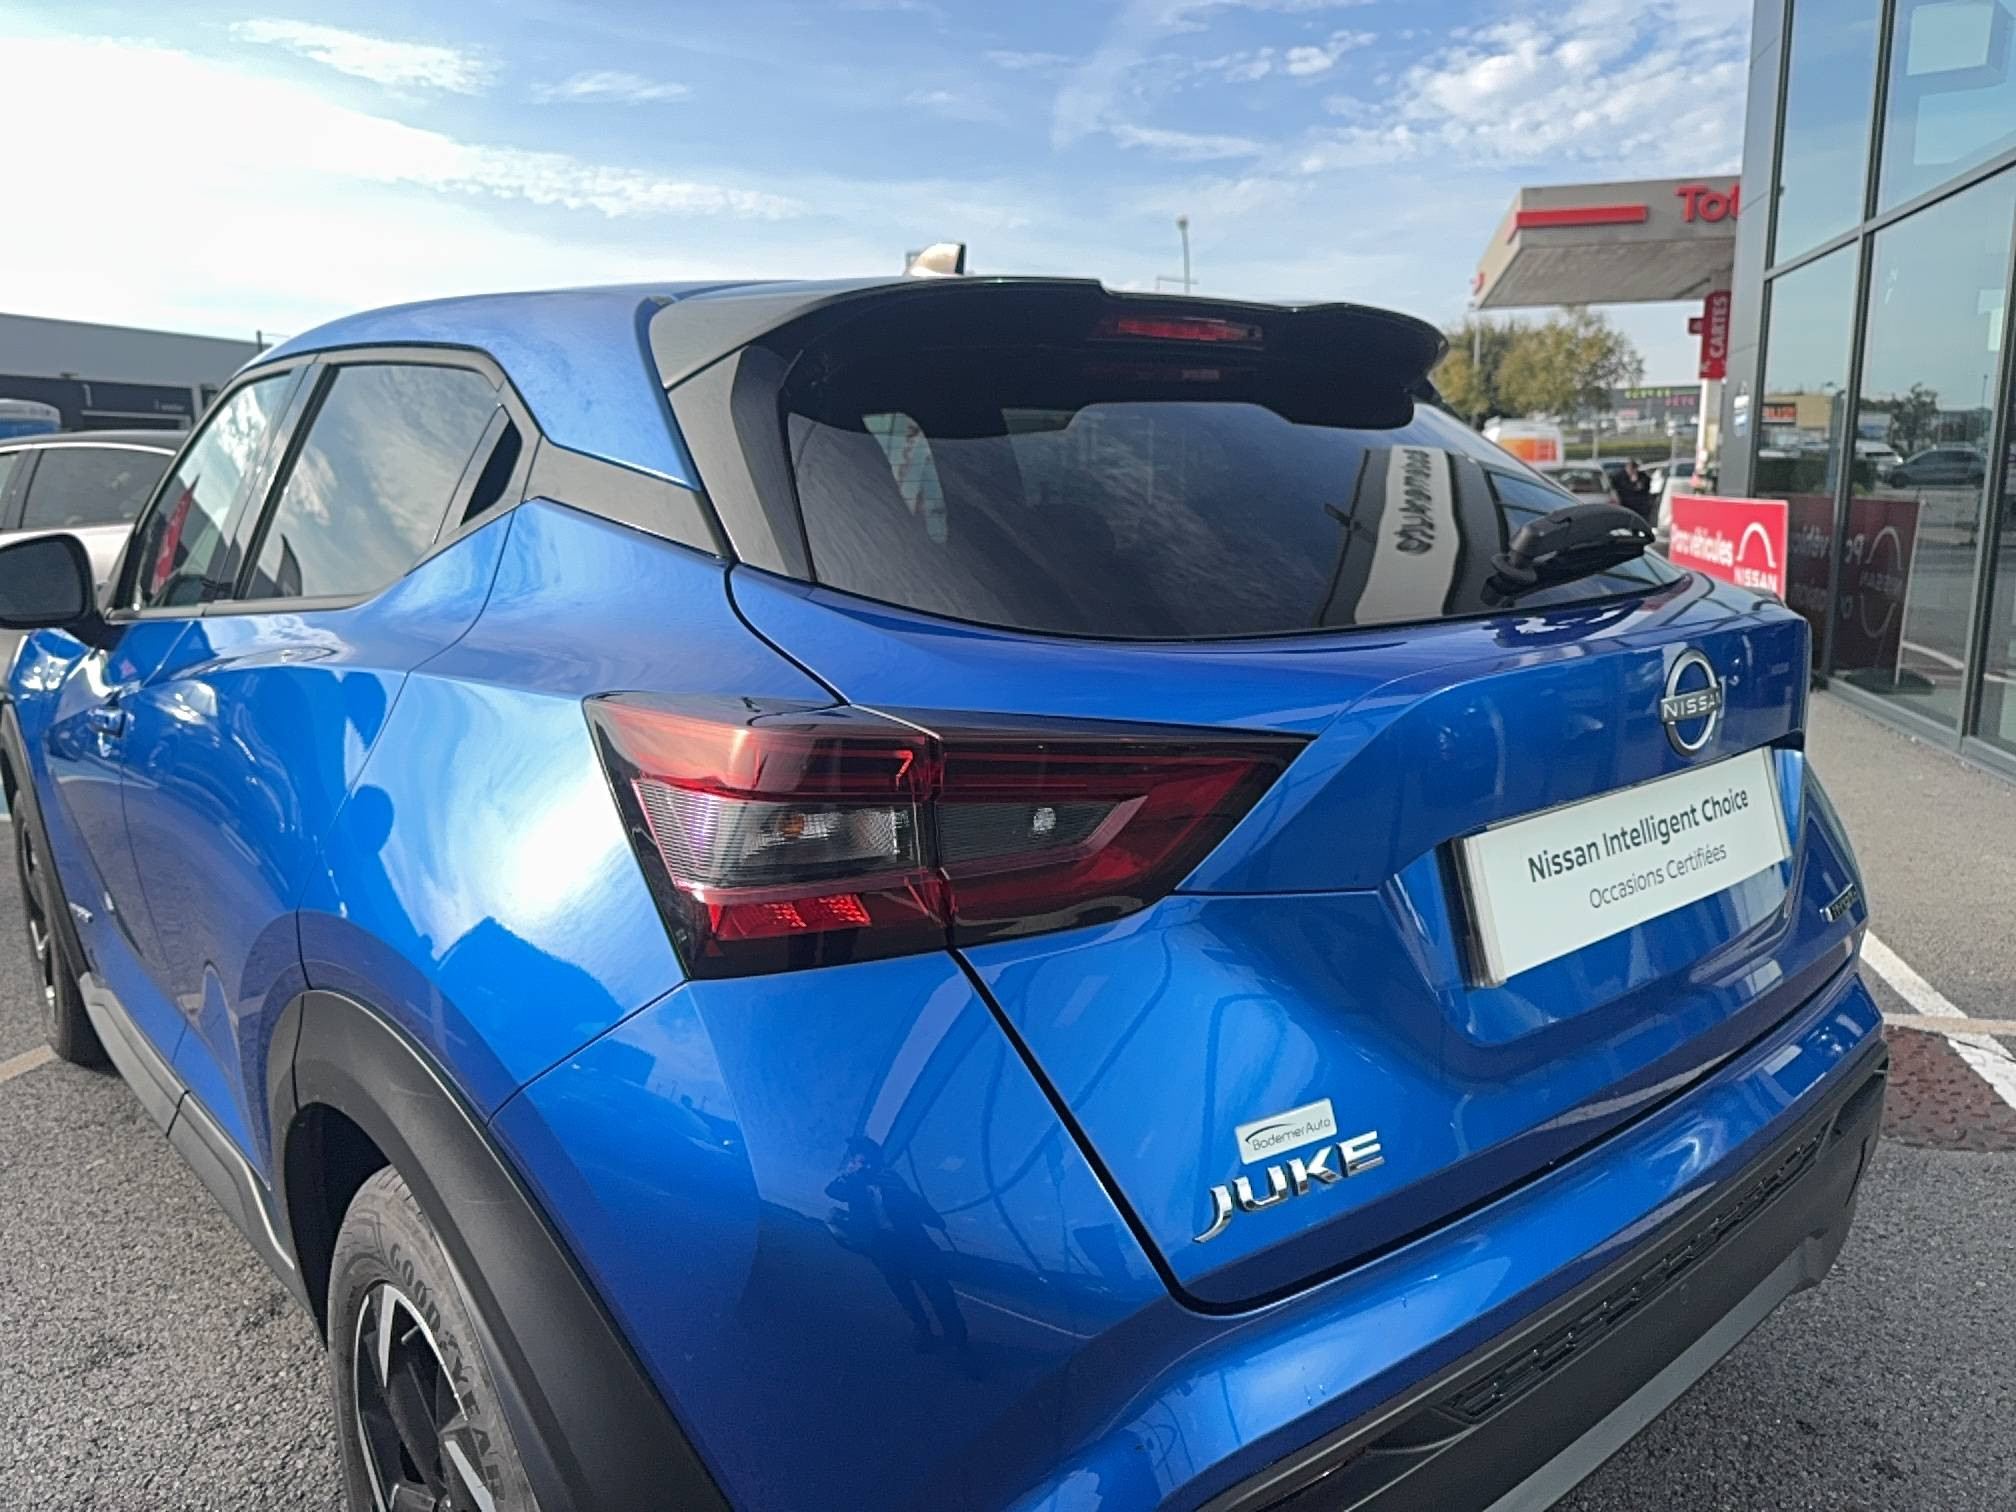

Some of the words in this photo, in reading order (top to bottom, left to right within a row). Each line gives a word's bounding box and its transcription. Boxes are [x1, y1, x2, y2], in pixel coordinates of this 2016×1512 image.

[1709, 296, 1729, 358] CARTES
[1734, 567, 1778, 592] NISSAN
[1663, 692, 1721, 719] NISSAN
[1527, 839, 1602, 883] Nissan
[1604, 805, 1700, 858] Intelligent
[1701, 788, 1749, 825] Choice
[1589, 863, 1665, 909] Occasions
[1666, 842, 1727, 879] Certifiées
[1192, 1130, 1385, 1244] JUKE
